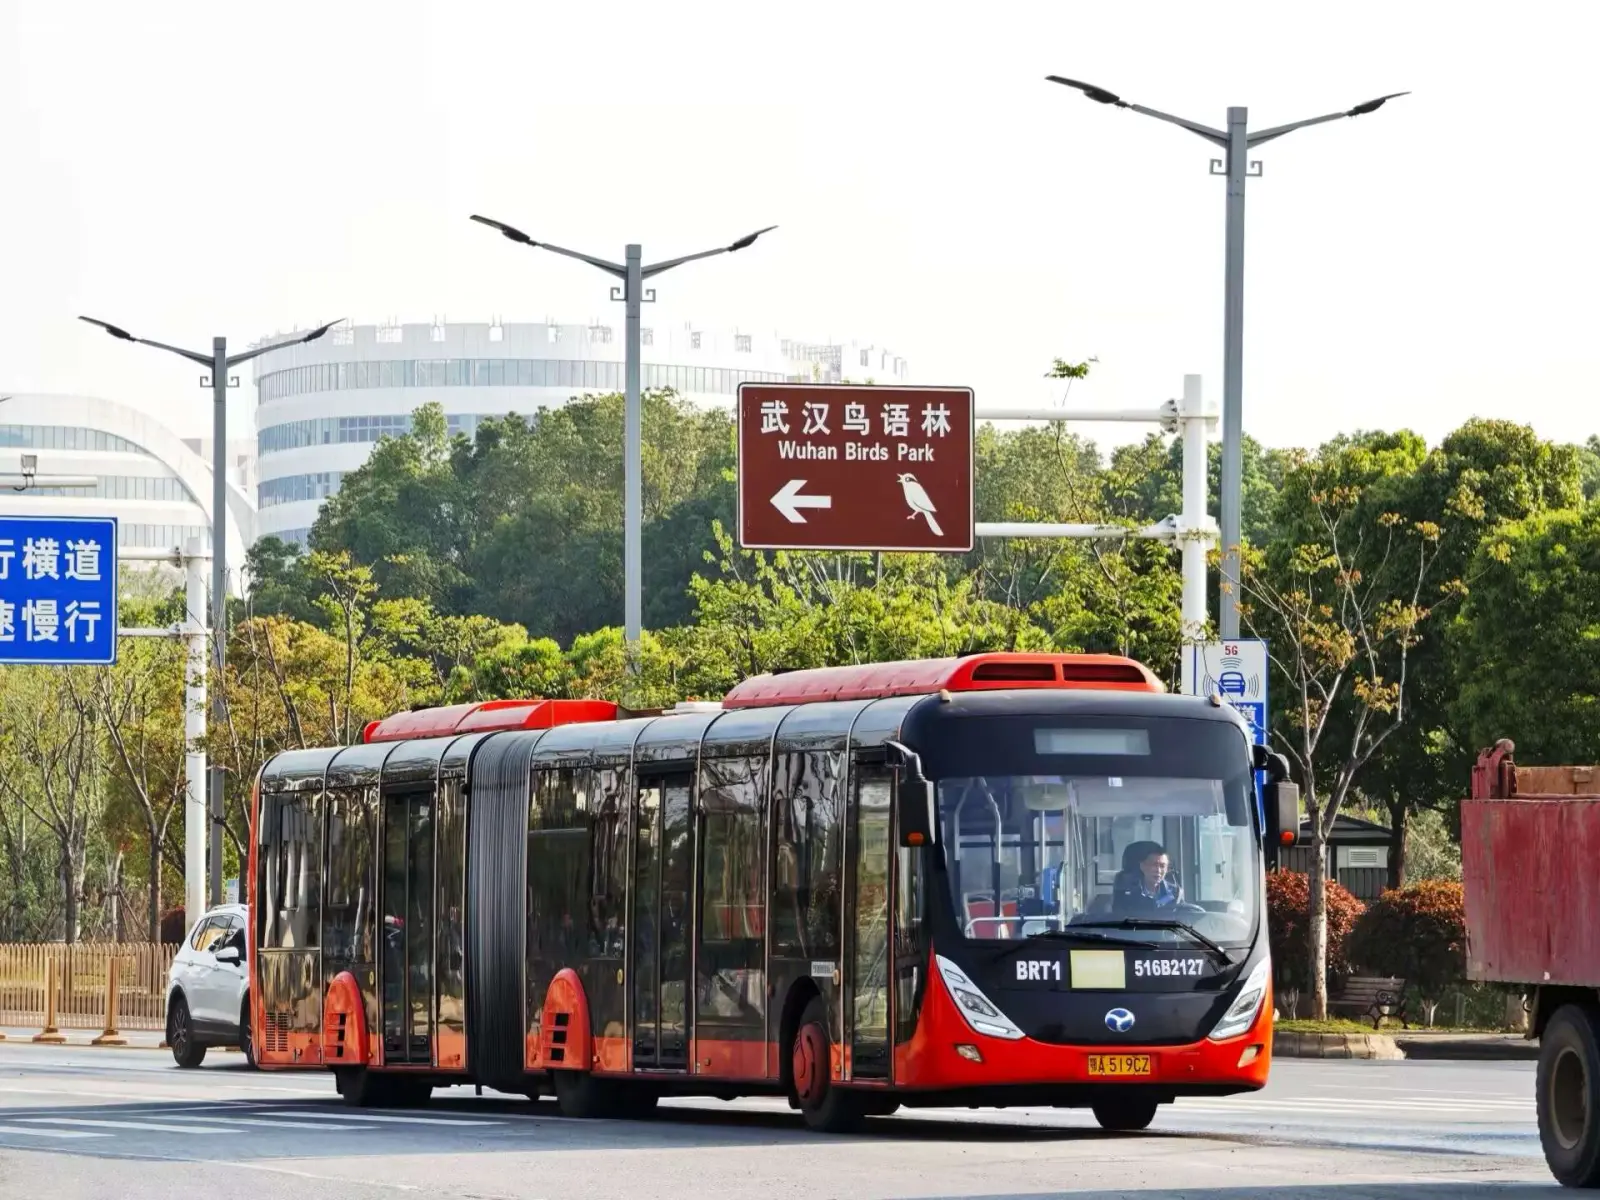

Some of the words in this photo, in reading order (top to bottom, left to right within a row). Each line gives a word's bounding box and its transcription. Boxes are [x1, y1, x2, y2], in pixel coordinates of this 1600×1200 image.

[760, 400, 951, 437] 武汉鸟语林
[778, 440, 838, 460] Wuhan
[845, 442, 890, 461] Birds
[897, 443, 935, 462] Park
[1224, 645, 1239, 656] 5G
[1016, 960, 1061, 980] BRT1
[1134, 959, 1203, 976] 516B2127
